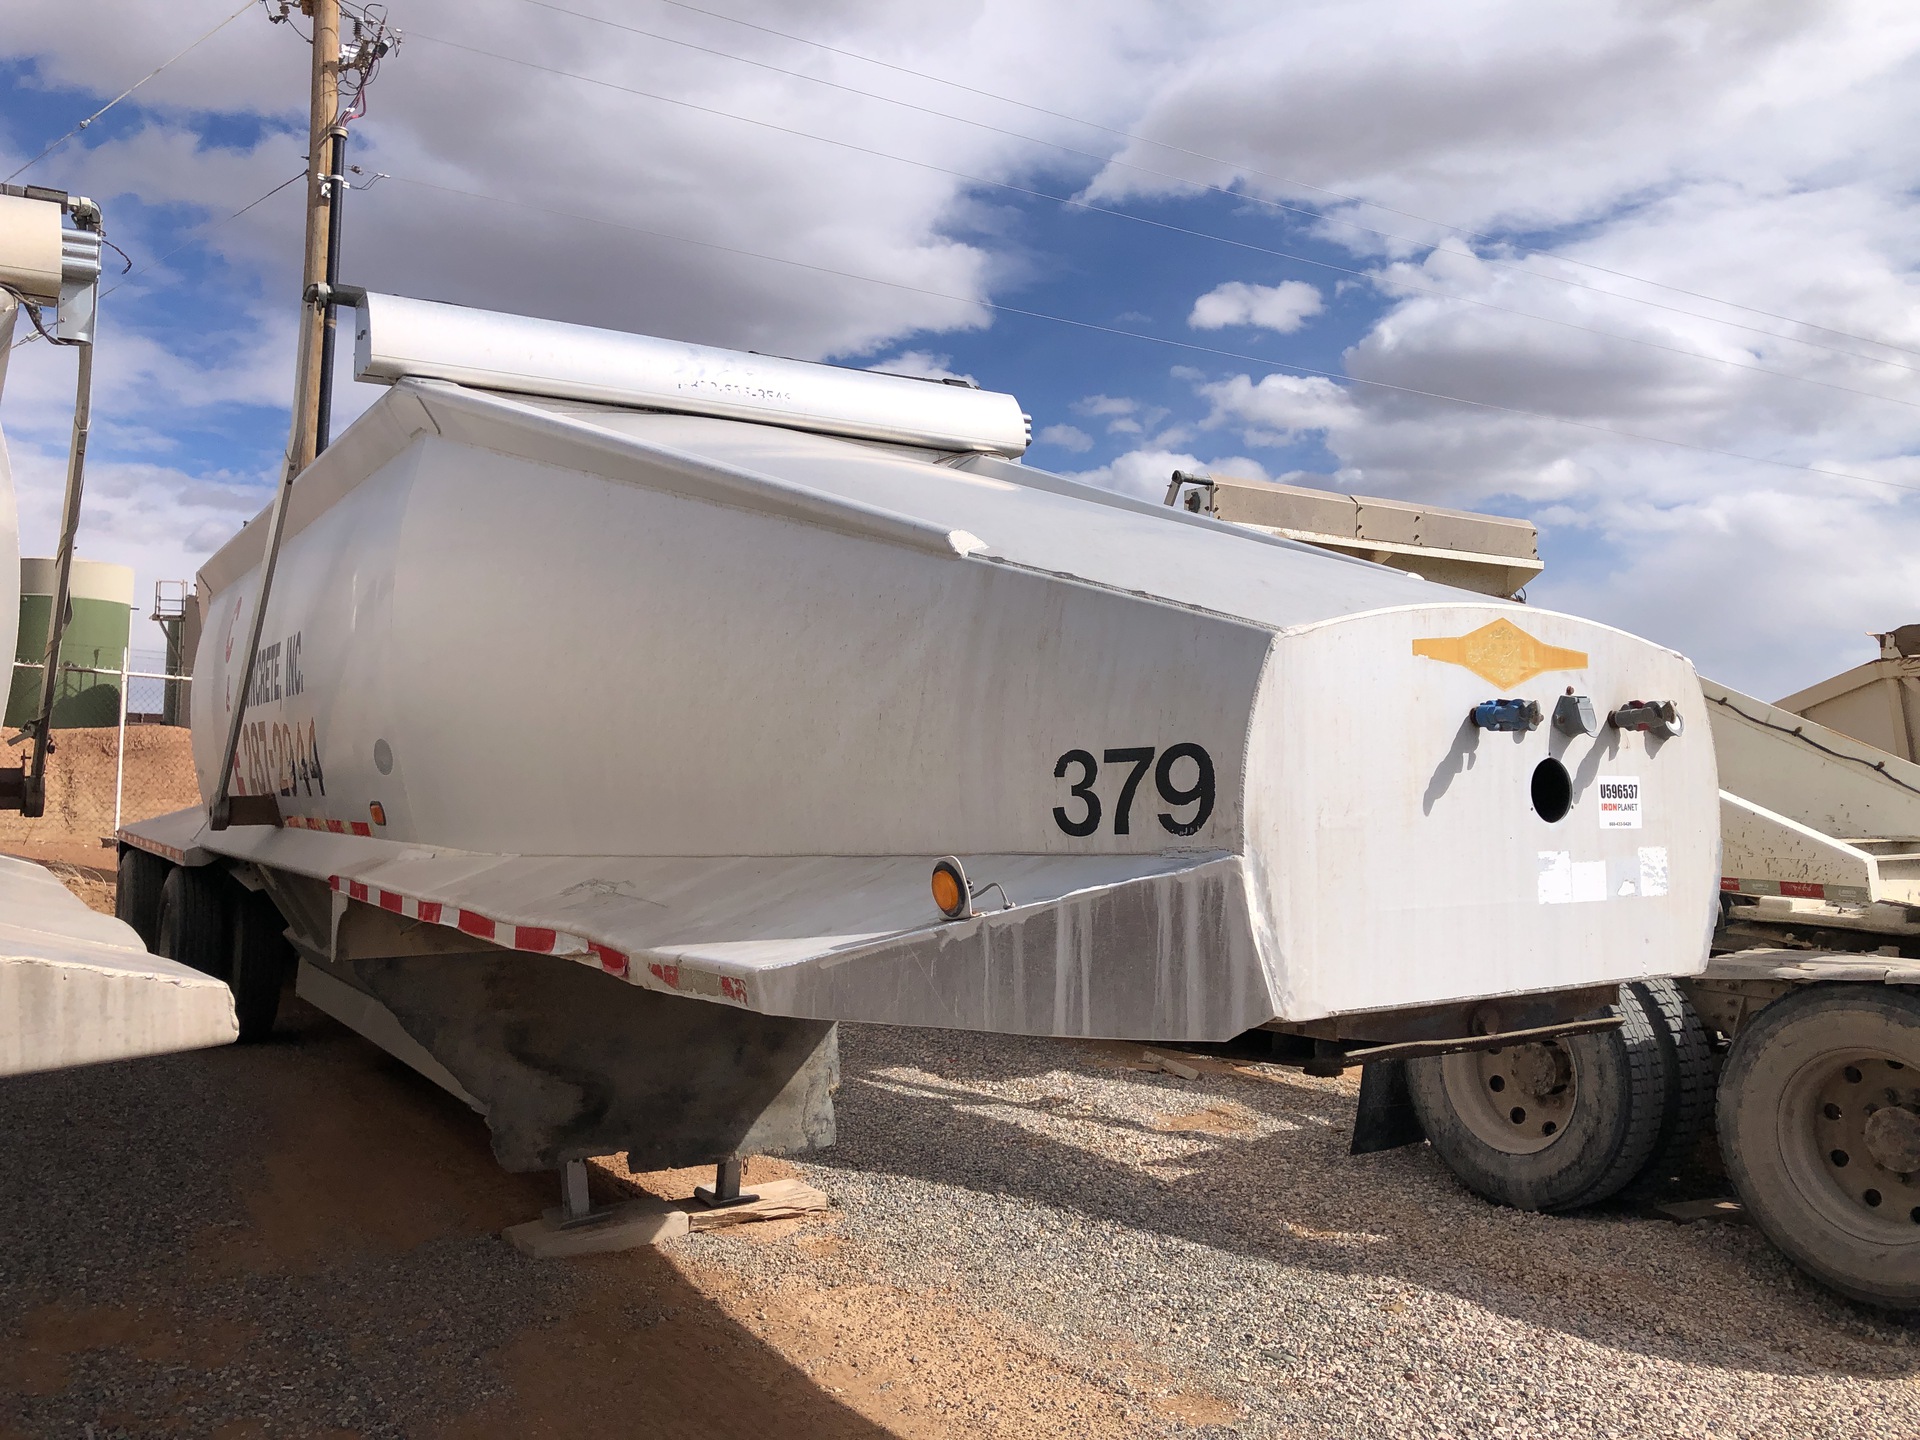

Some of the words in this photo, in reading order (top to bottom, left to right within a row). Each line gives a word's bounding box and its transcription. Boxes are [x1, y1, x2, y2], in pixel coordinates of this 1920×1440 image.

[286, 630, 304, 697] INC.
[1052, 742, 1216, 837] 379
[1600, 784, 1638, 799] U596537
